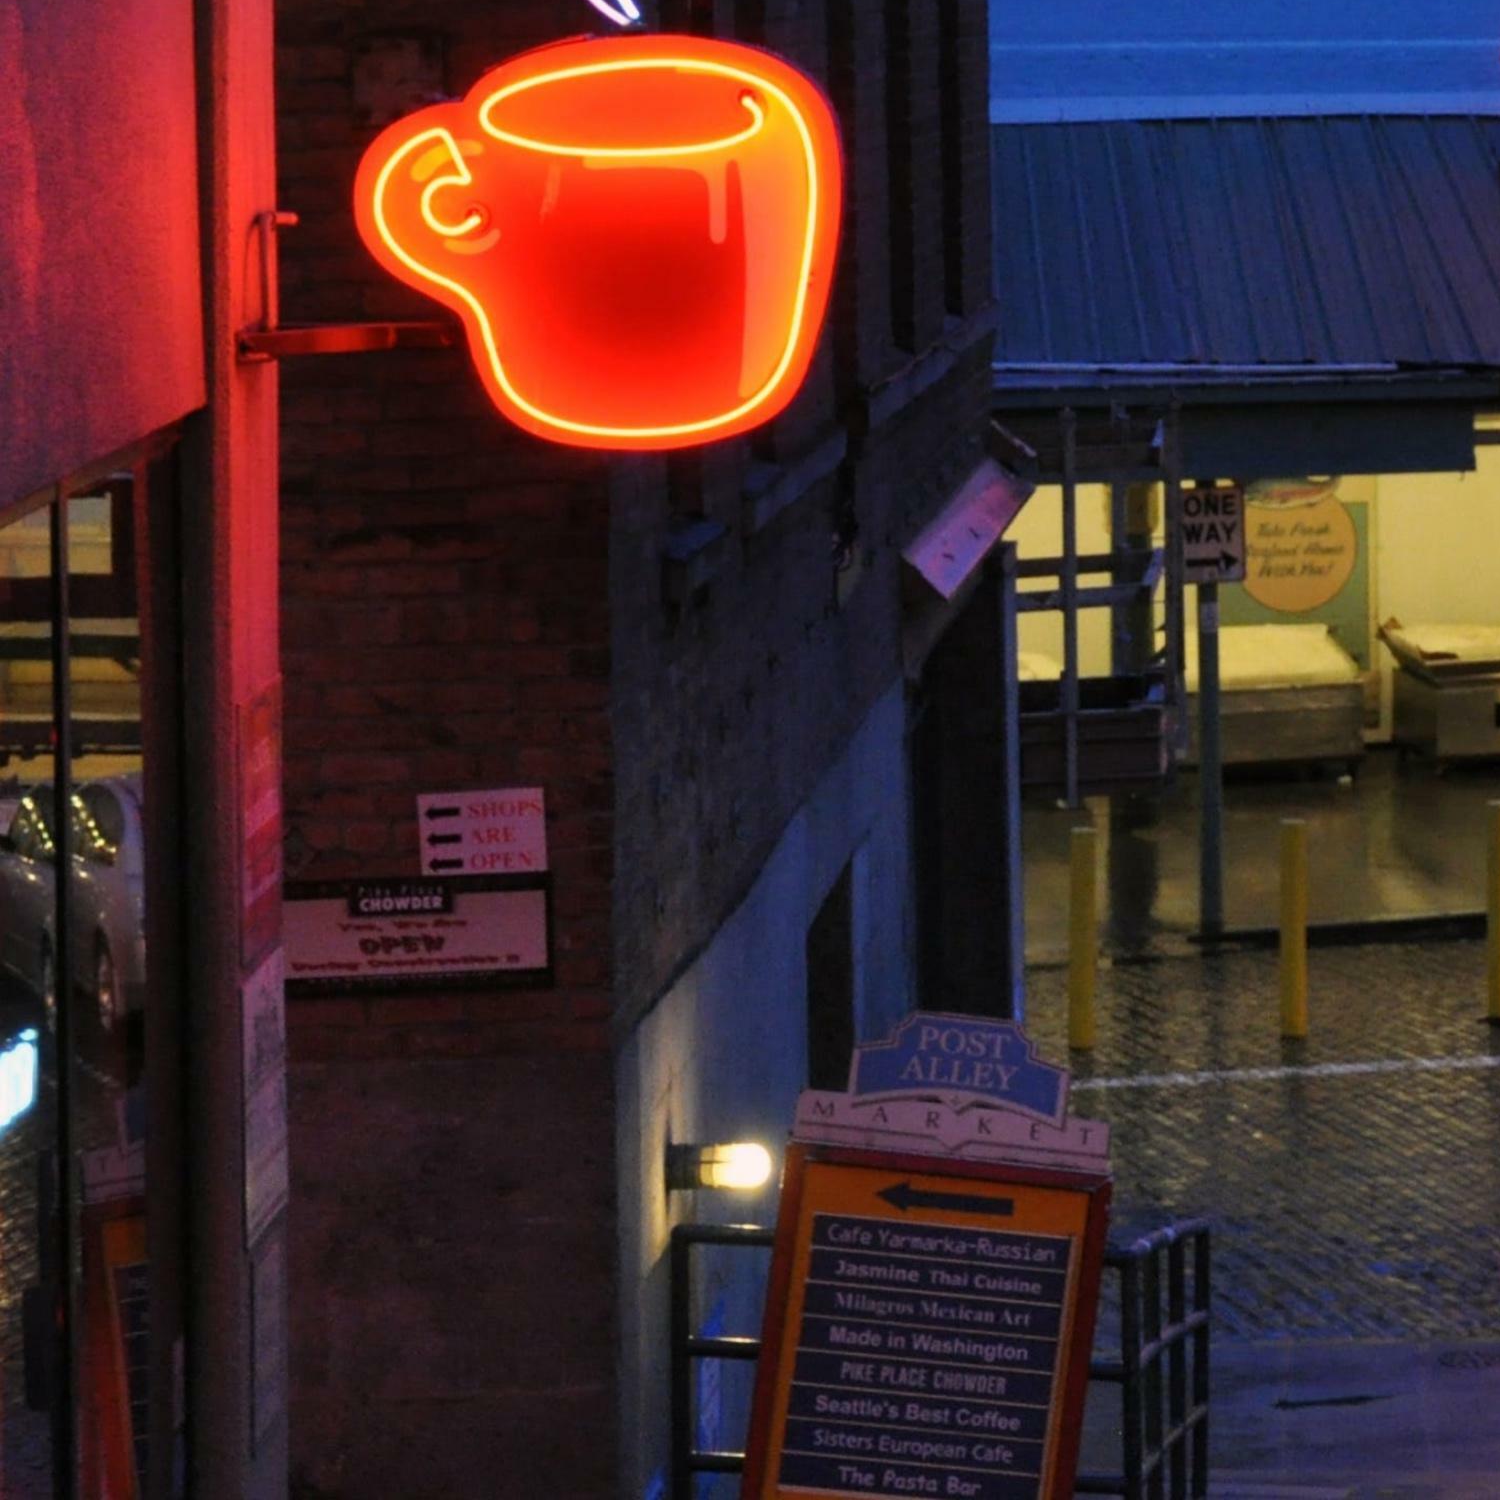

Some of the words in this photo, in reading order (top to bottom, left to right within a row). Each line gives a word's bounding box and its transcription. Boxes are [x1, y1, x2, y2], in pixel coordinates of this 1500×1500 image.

[1183, 494, 1237, 518] ONE
[1183, 522, 1239, 545] WAY
[467, 799, 542, 819] SHOPS
[472, 827, 516, 845] ARE
[469, 851, 533, 870] OPEN
[358, 896, 444, 912] CHOWDER
[358, 933, 446, 954] OPEN
[918, 1024, 1011, 1060] POST
[899, 1055, 1021, 1092] ALLEY
[810, 1099, 1094, 1148] MARKET
[827, 1223, 873, 1246] Cafe
[877, 1228, 1057, 1263] Yarmarka-Russian
[834, 1259, 921, 1283] Jasmine
[929, 1269, 969, 1288] Thai
[973, 1275, 1043, 1295] Cuisine
[834, 1292, 915, 1315] Milagros
[920, 1301, 996, 1324] Mexican
[1001, 1310, 1032, 1327] Art
[828, 1325, 882, 1347] Made
[887, 1332, 906, 1348] in
[912, 1333, 1029, 1363] Washington
[840, 1361, 875, 1383] PIKE
[879, 1365, 928, 1389] PLACE
[933, 1370, 1008, 1396] CHOWDER
[815, 1395, 900, 1420] Seattle's
[904, 1402, 950, 1424] Best
[955, 1408, 1022, 1432] Coffee
[812, 1429, 874, 1451] Sisters
[878, 1435, 968, 1461] European
[971, 1444, 1014, 1465] Cafe
[837, 1465, 876, 1487] The
[882, 1469, 939, 1493] Pasta
[945, 1475, 983, 1497] Bar
